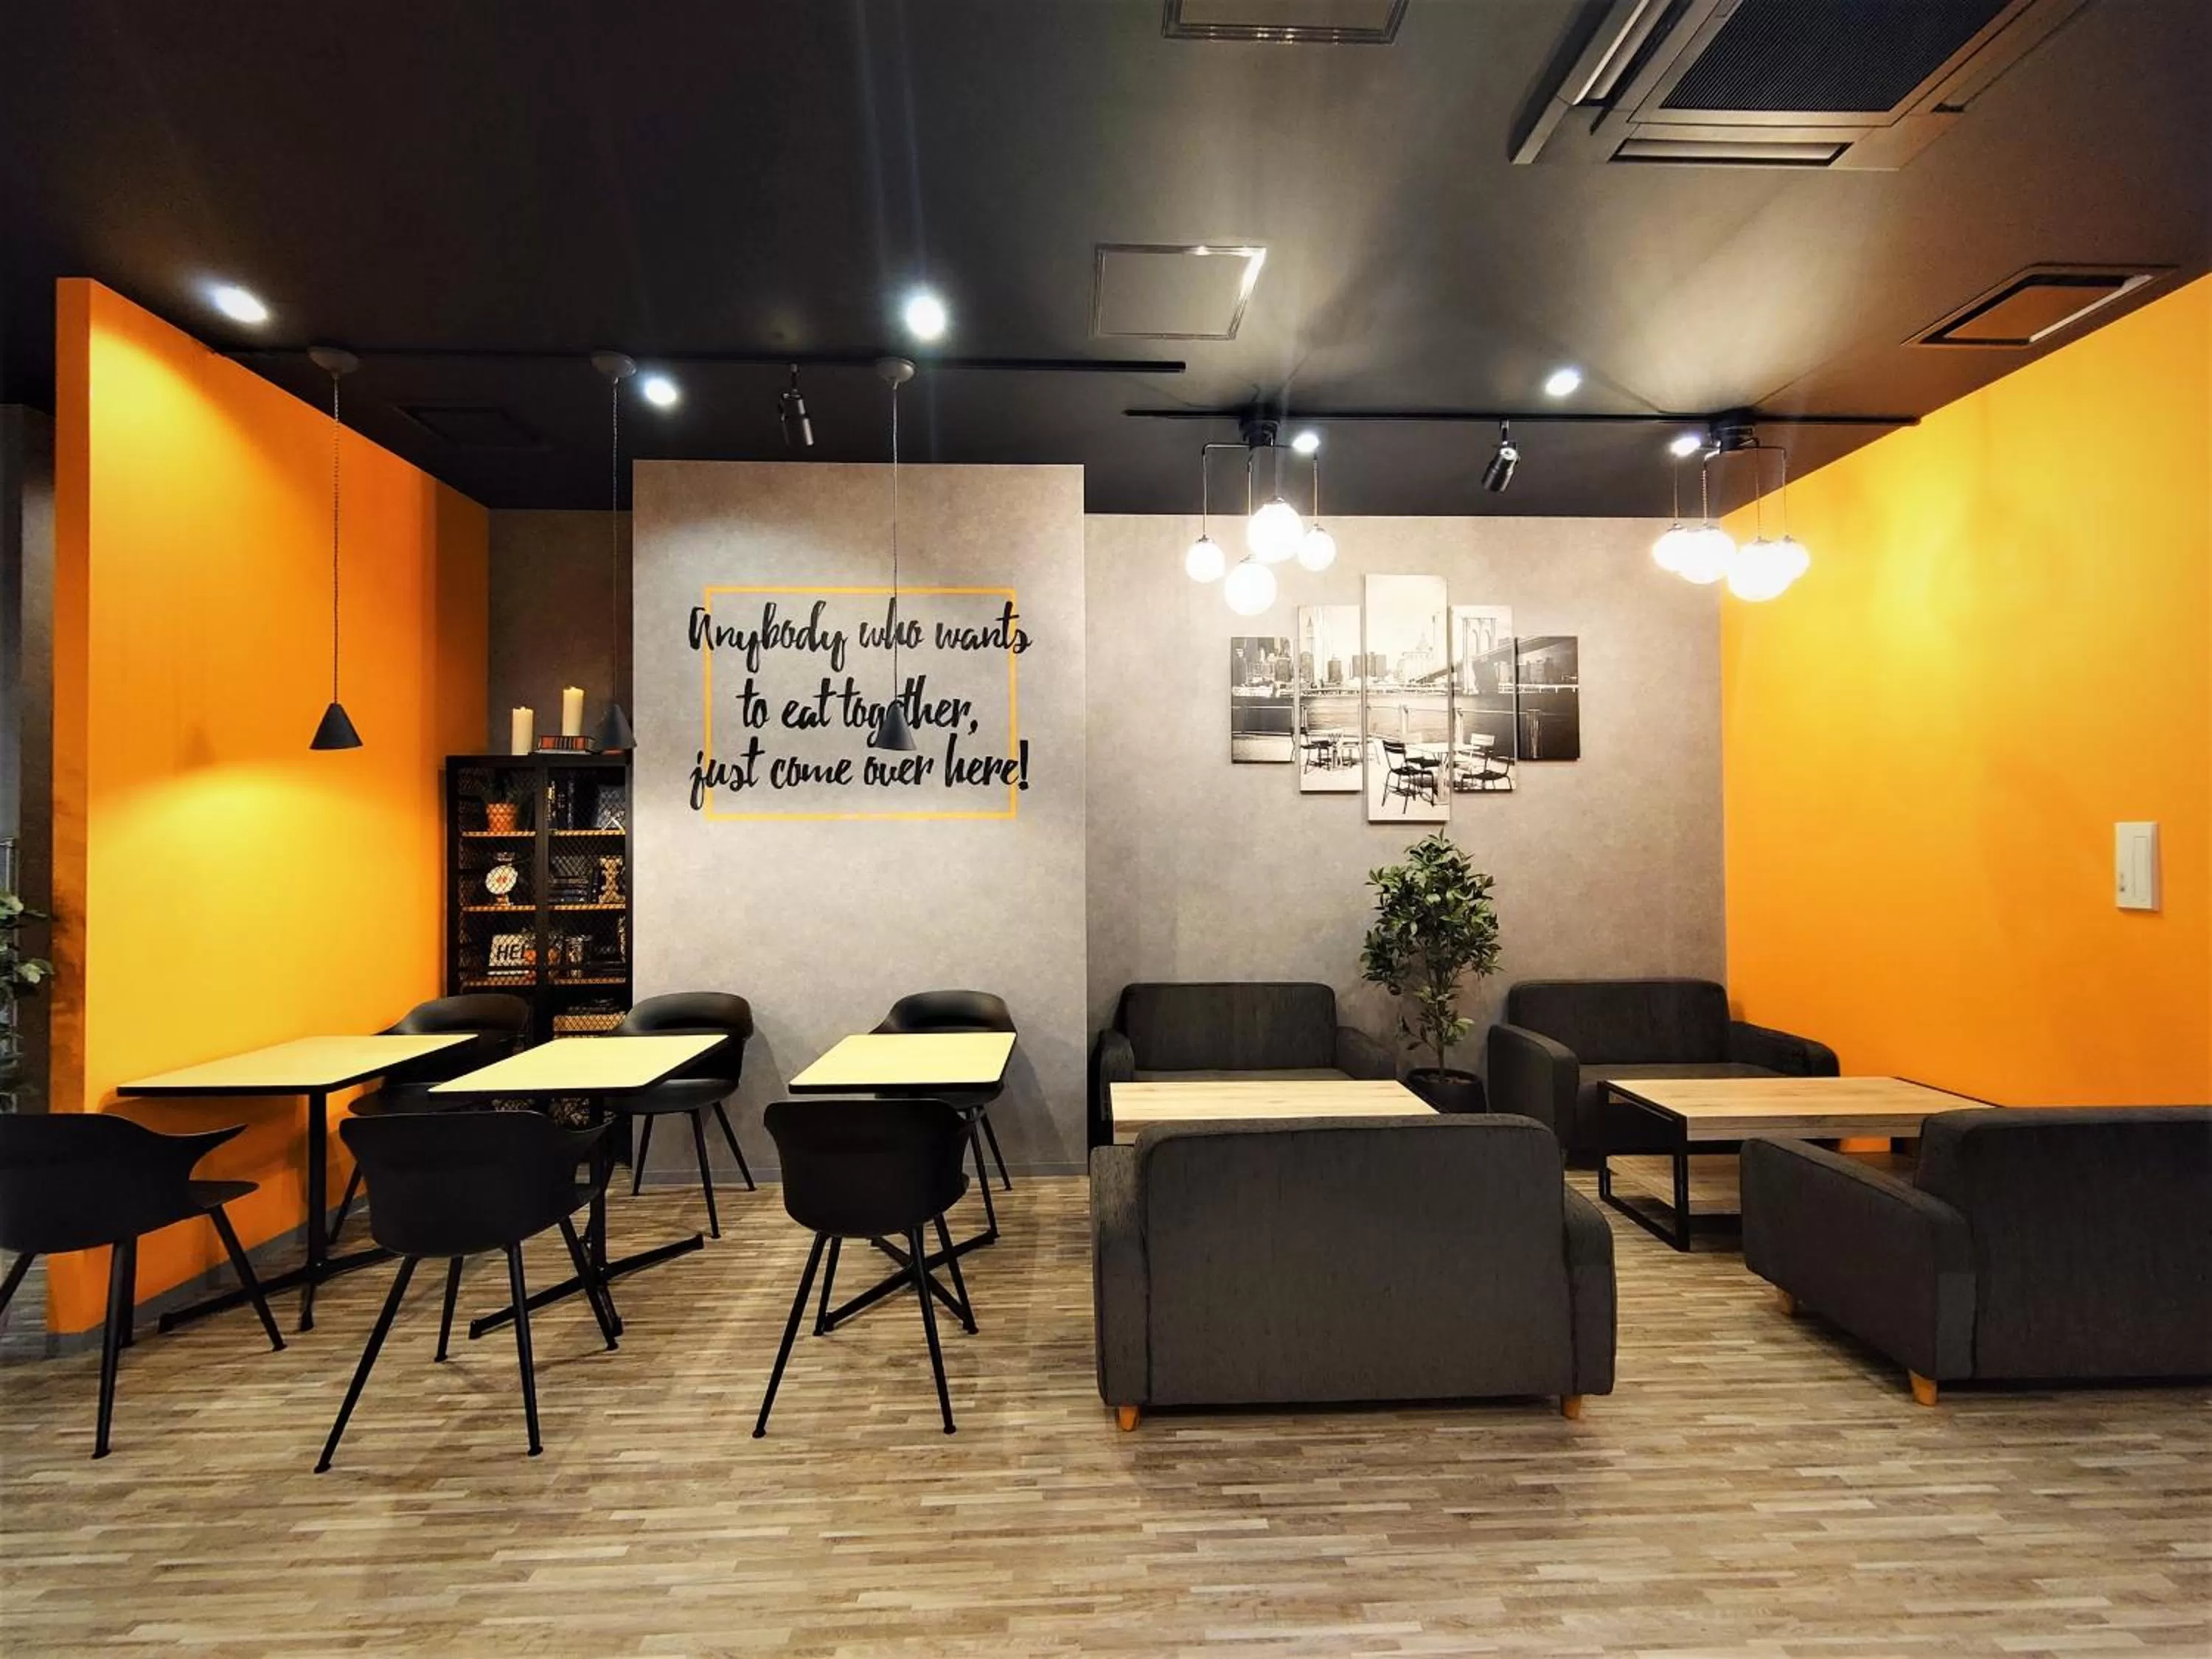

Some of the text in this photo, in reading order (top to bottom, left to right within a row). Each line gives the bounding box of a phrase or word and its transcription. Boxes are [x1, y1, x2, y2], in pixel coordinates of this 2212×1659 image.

[689, 597, 1033, 672] Anybody who wants
[736, 678, 768, 728] to
[782, 678, 837, 728] eat
[690, 732, 1029, 810] just come over here!
